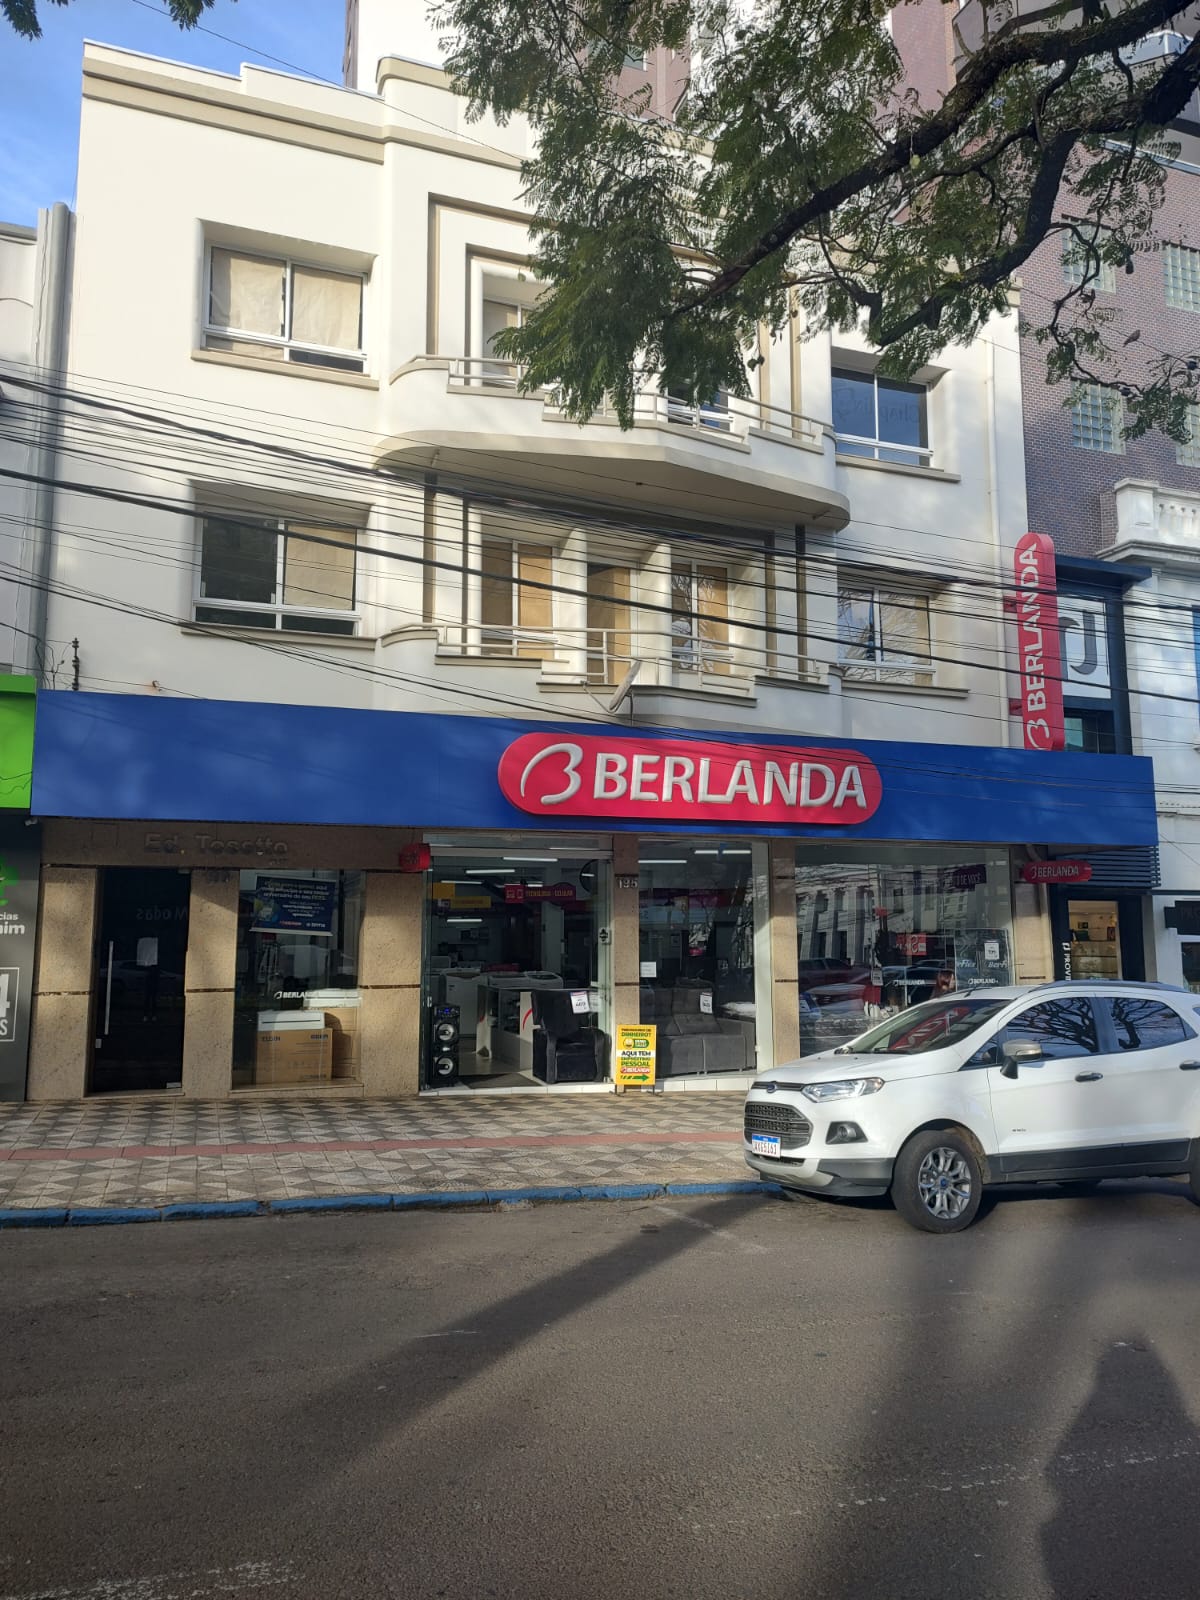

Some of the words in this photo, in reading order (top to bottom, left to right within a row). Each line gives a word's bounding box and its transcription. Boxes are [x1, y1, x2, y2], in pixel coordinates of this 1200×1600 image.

[1018, 543, 1047, 712] BERLANDA
[593, 752, 868, 809] BERLANDA
[1037, 865, 1080, 878] BERLANDA
